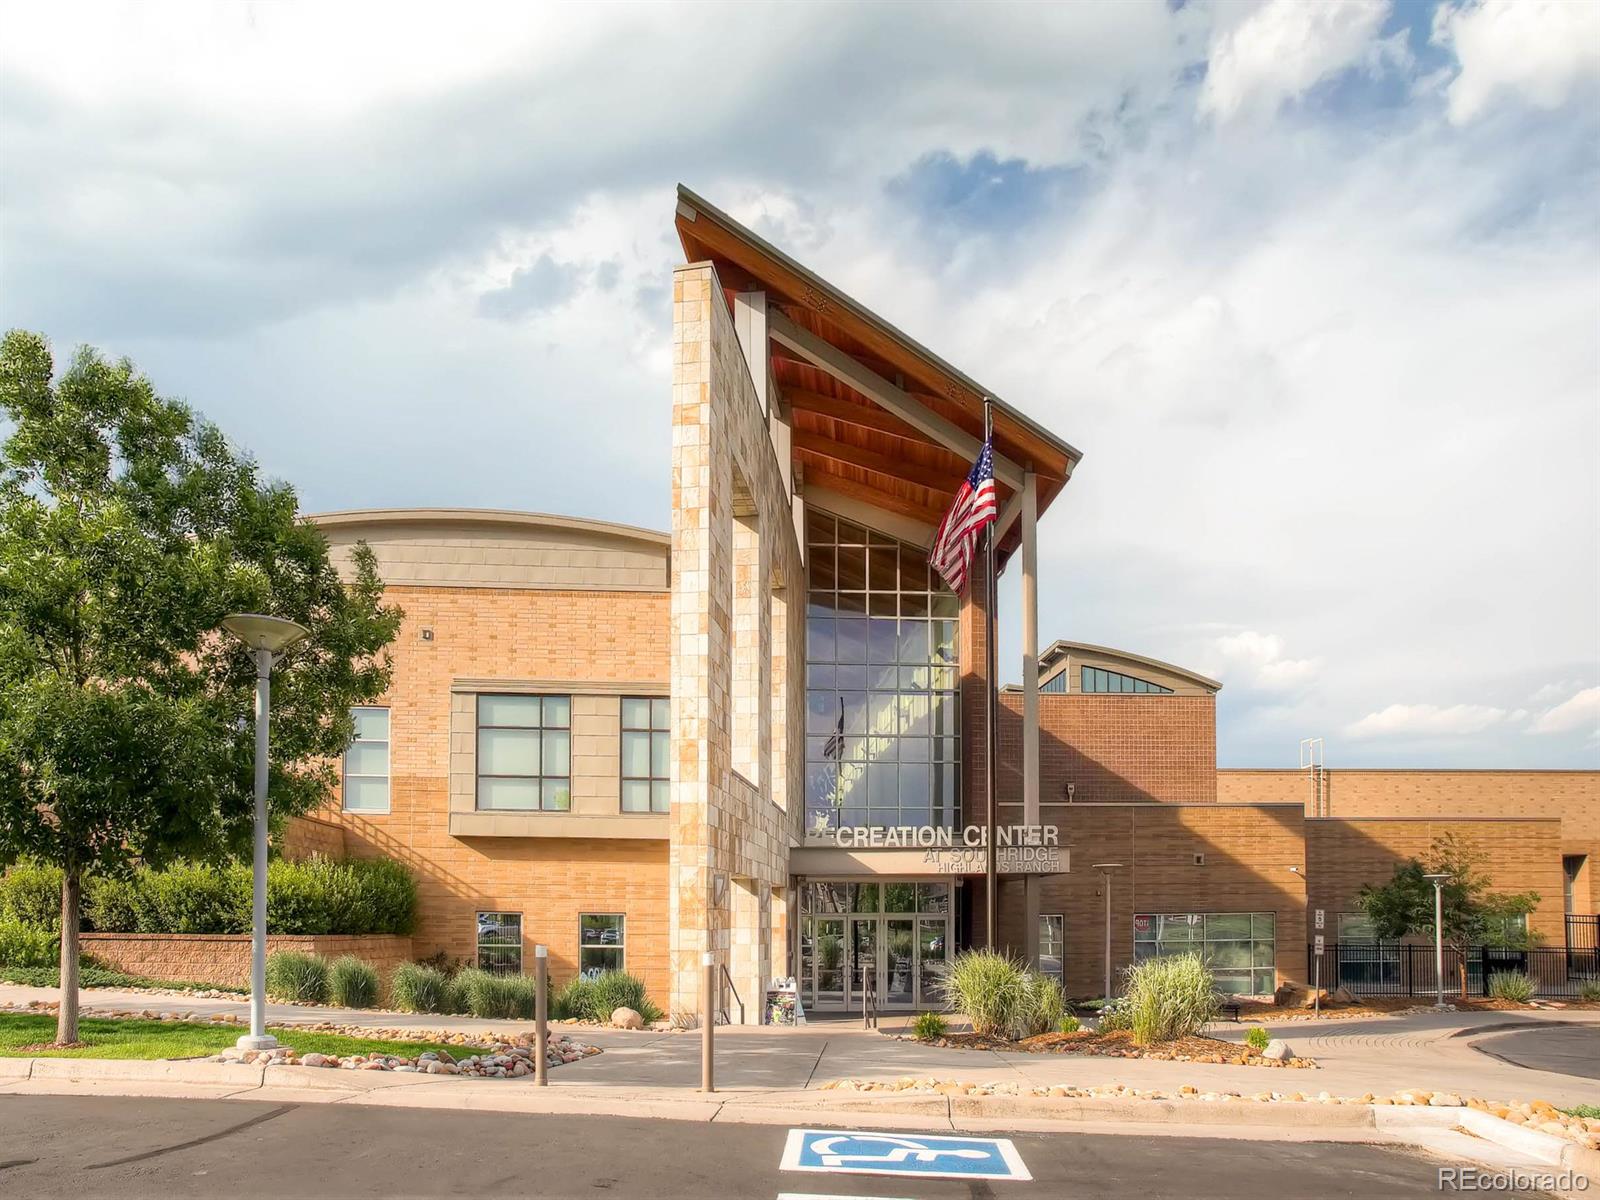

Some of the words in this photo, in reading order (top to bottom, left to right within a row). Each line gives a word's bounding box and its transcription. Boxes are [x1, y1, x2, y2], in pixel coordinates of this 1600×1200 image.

[924, 848, 942, 863] AT
[951, 847, 1058, 862] SOUHRIDGE
[938, 861, 1009, 873] HIGHLAS
[1015, 861, 1060, 873] RANCH
